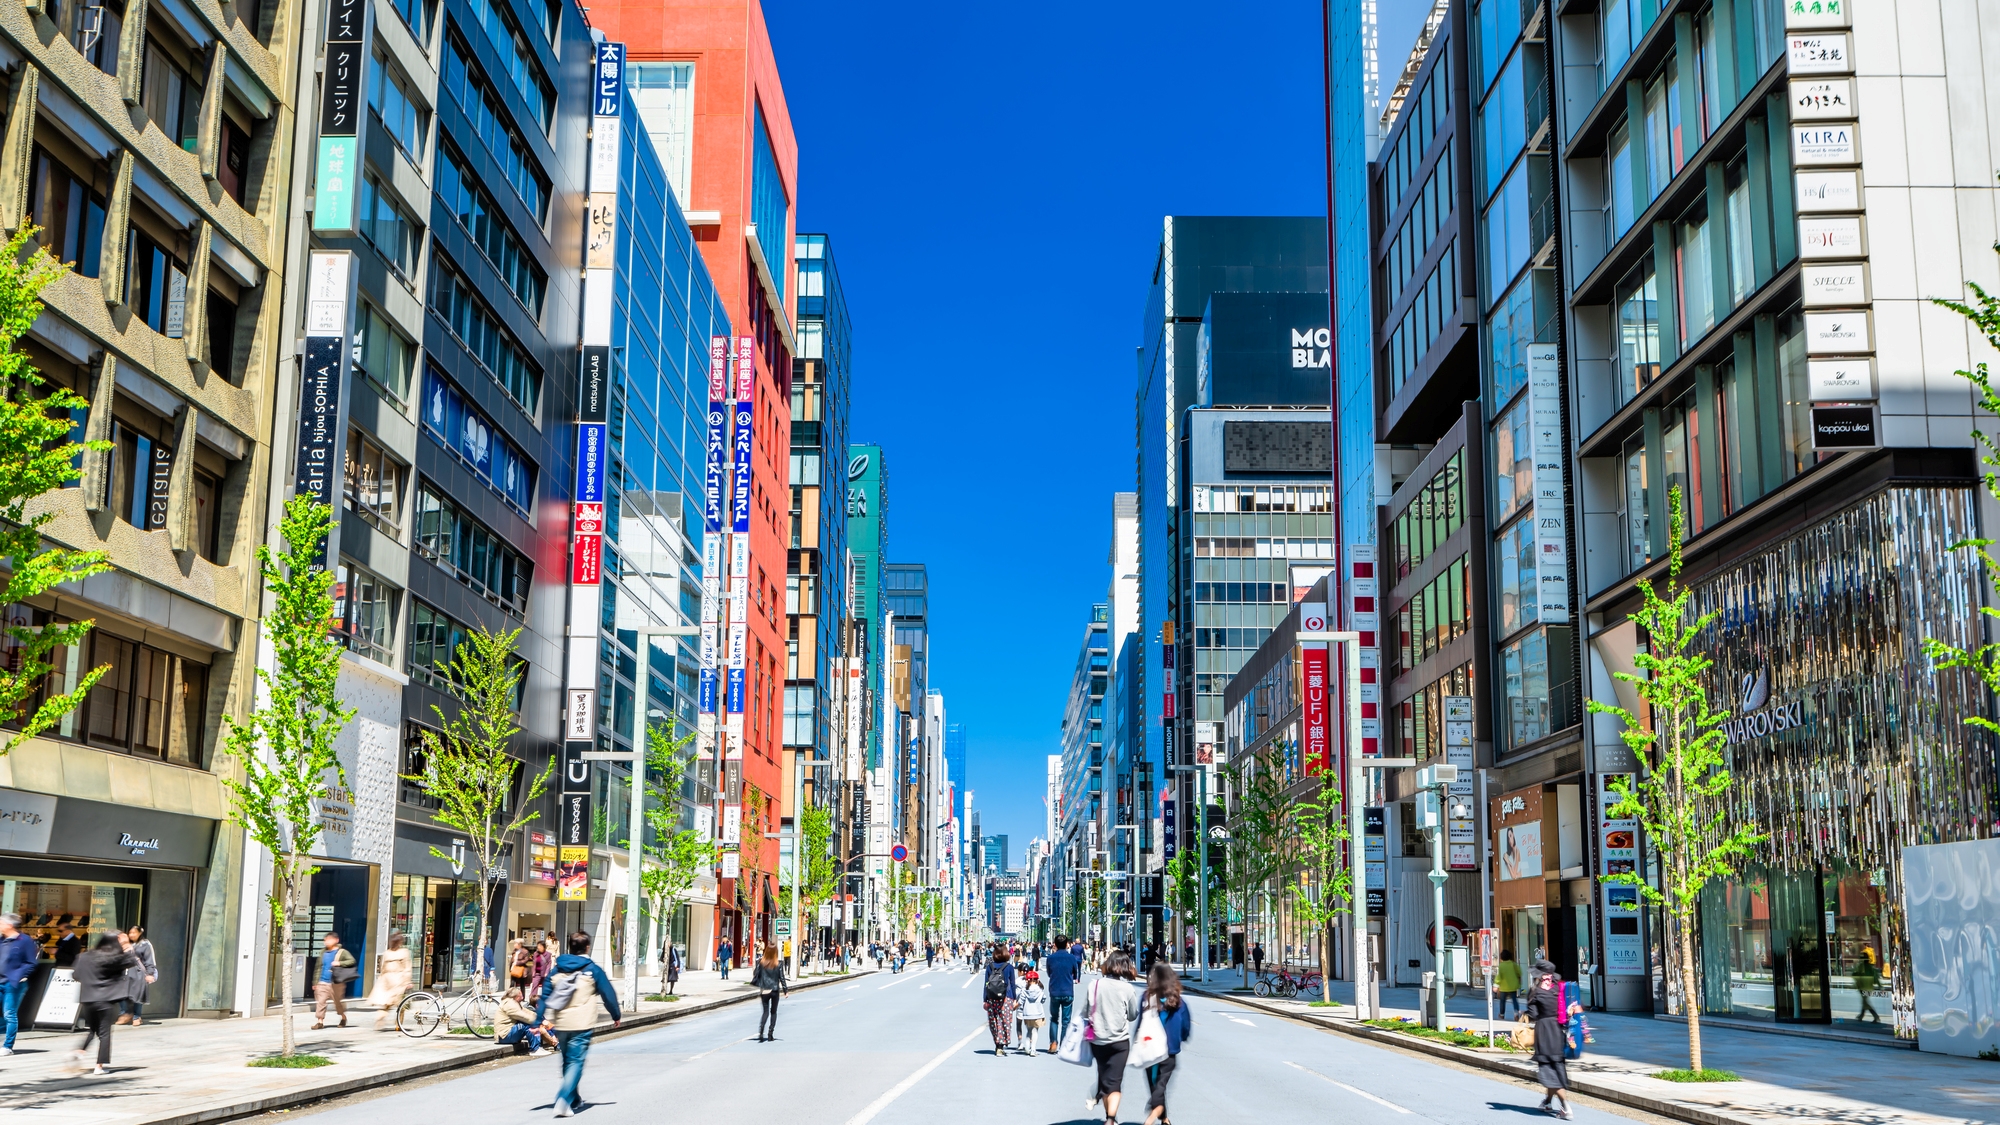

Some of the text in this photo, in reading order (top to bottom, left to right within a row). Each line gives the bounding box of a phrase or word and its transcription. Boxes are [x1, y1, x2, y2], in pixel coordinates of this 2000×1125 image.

[333, 52, 350, 126] クリニック
[599, 44, 619, 115] 太陽ビル
[1801, 131, 1848, 144] KIRA
[1813, 276, 1856, 287] SIECLE
[315, 366, 329, 414] SOPHIA
[590, 355, 602, 413] matsukiyoLAB
[313, 415, 327, 443] bijou
[1819, 424, 1870, 434] kappou ukai
[735, 429, 750, 522] スペーストラスト
[1543, 490, 1557, 498] HRC
[1541, 518, 1561, 528] ZEN
[733, 683, 741, 711] TORAIZ
[1308, 661, 1326, 753] 三菱UFJ銀行
[575, 693, 587, 735] 星乃珈琲店
[569, 764, 588, 783] U
[119, 833, 160, 849] Runwalk
[322, 822, 347, 834] GINZA
